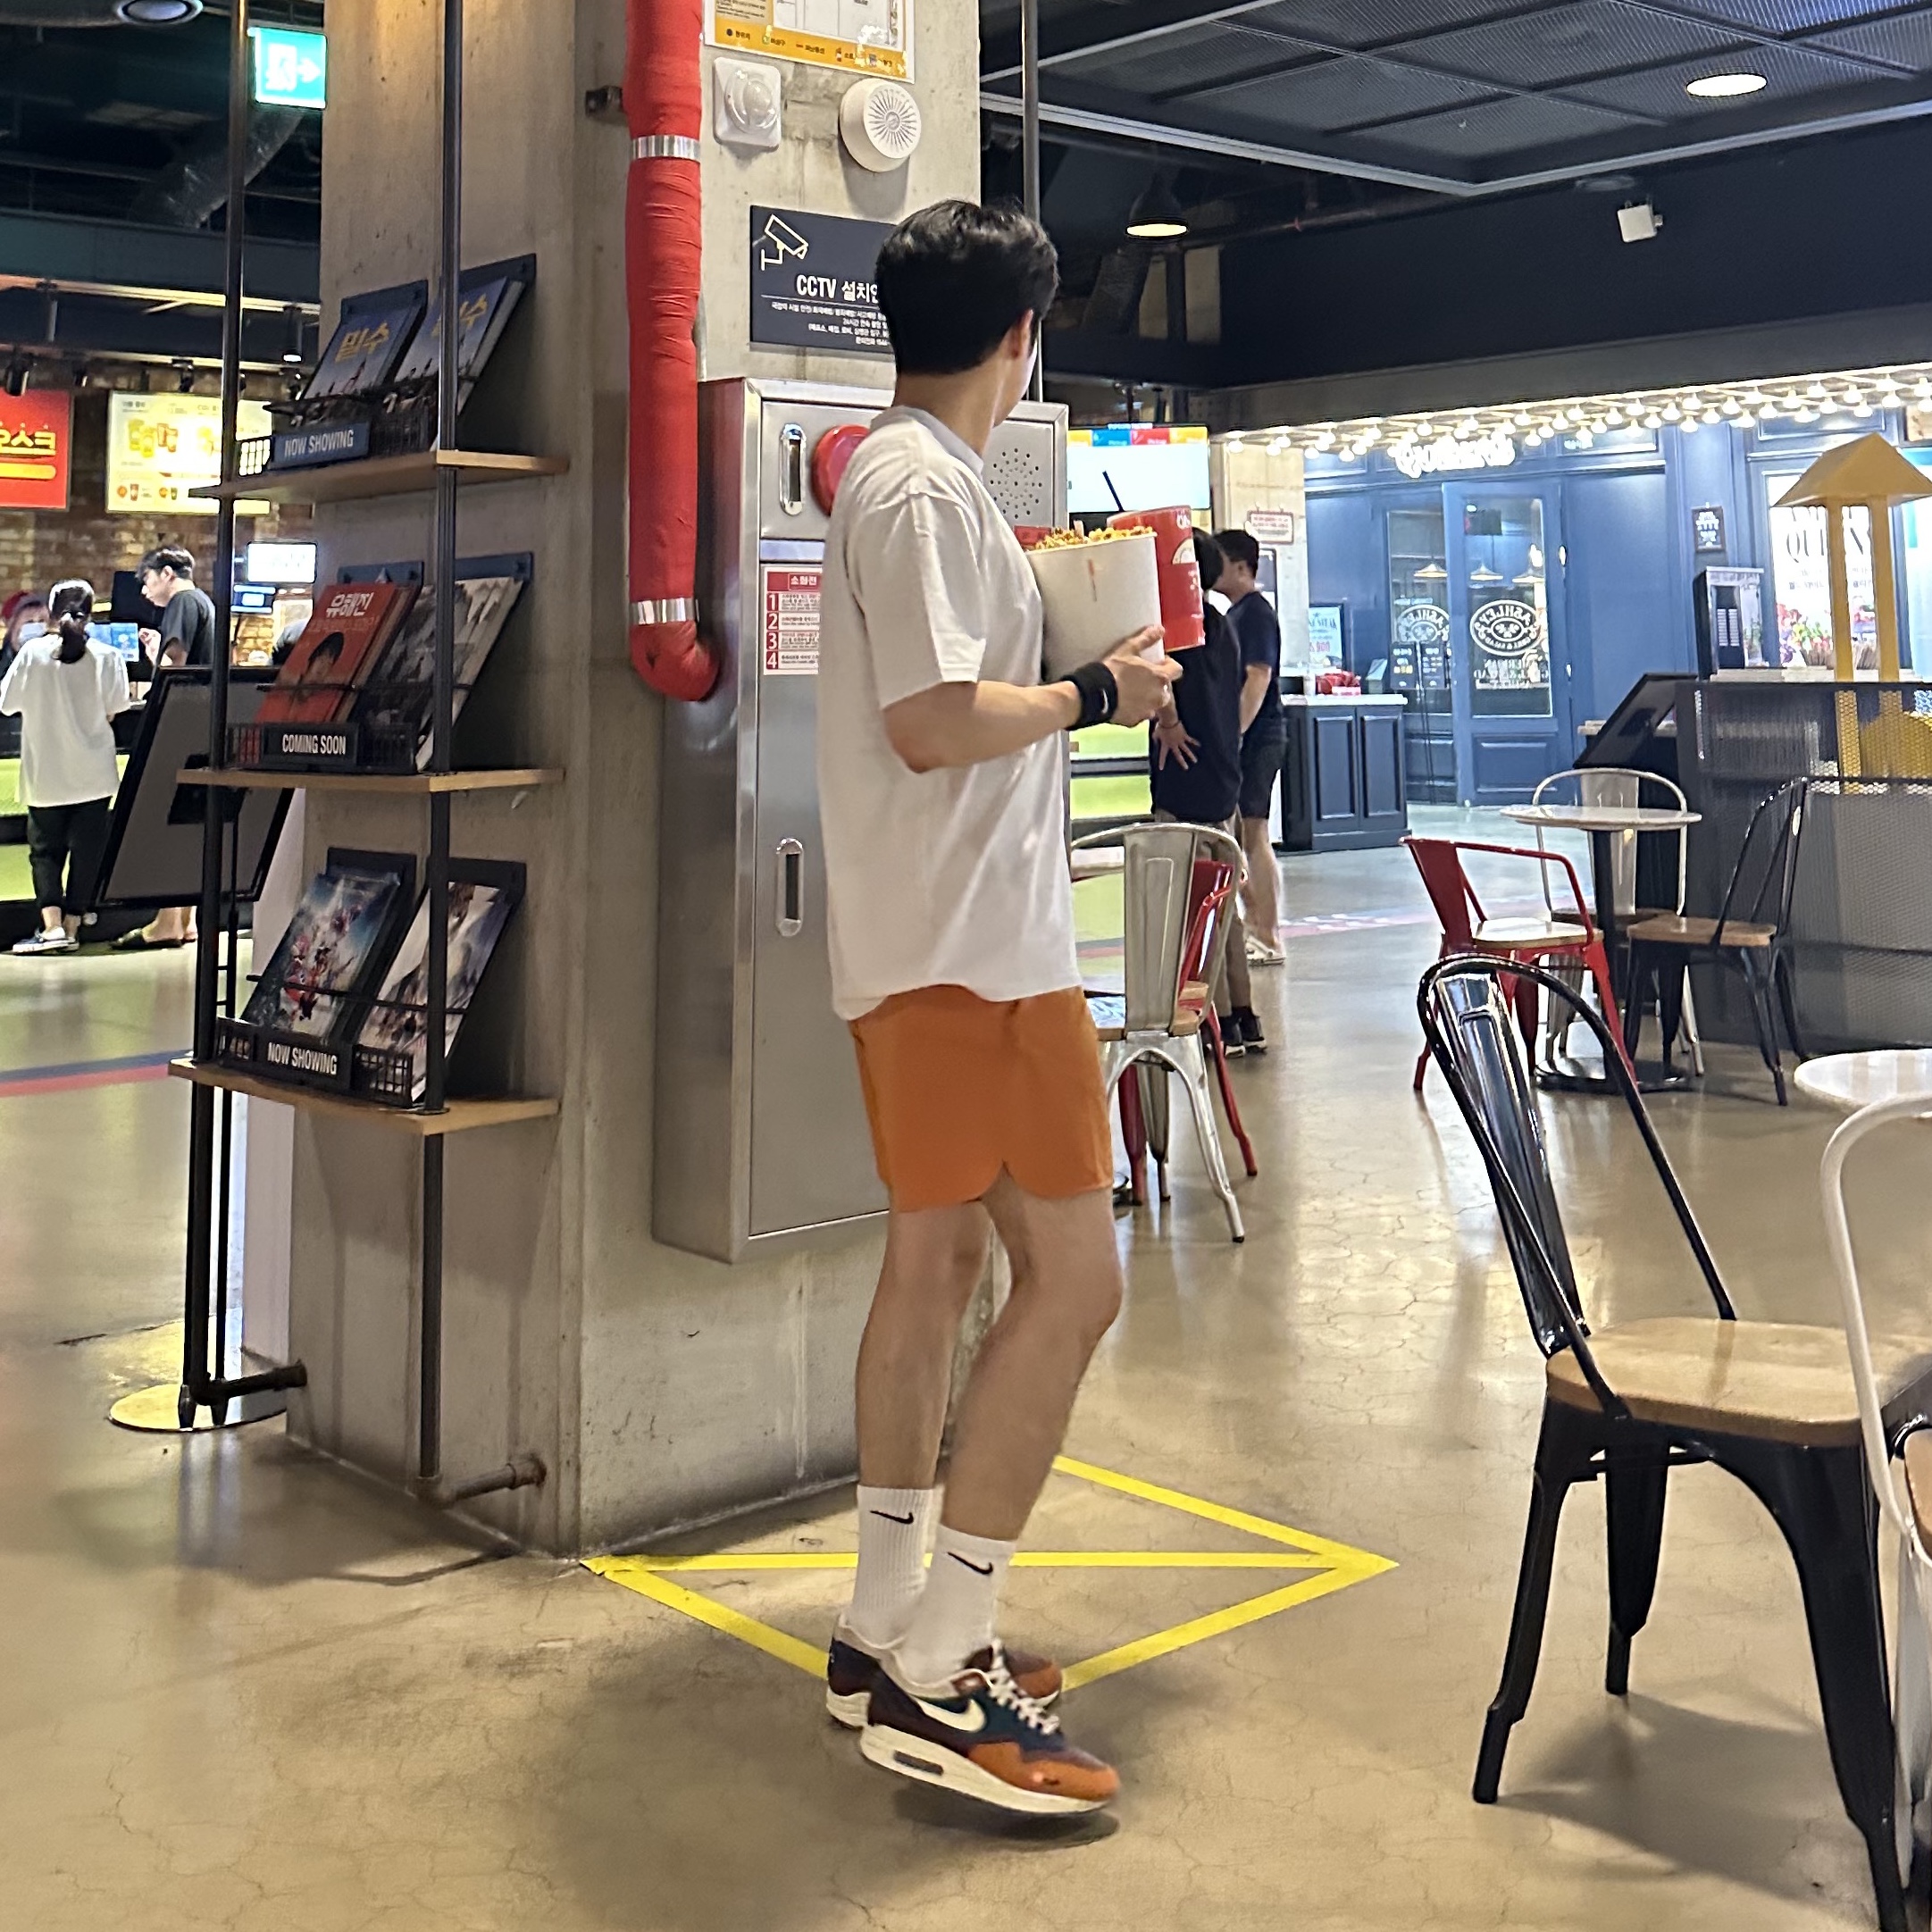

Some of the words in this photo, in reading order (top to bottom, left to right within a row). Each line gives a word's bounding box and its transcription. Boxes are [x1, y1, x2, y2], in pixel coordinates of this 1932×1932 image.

[796, 274, 837, 298] CCTV
[336, 322, 389, 362] 밀수
[284, 436, 307, 456] NOW
[306, 429, 355, 454] SHOWING
[326, 590, 375, 618] 유해진
[768, 594, 776, 611] 1
[768, 613, 778, 630] 2
[768, 632, 777, 649] 3
[767, 652, 777, 668] 4
[282, 734, 319, 754] COMING
[320, 734, 347, 755] SOON
[267, 1043, 290, 1065] NOW
[291, 1048, 338, 1075] SHOWING
